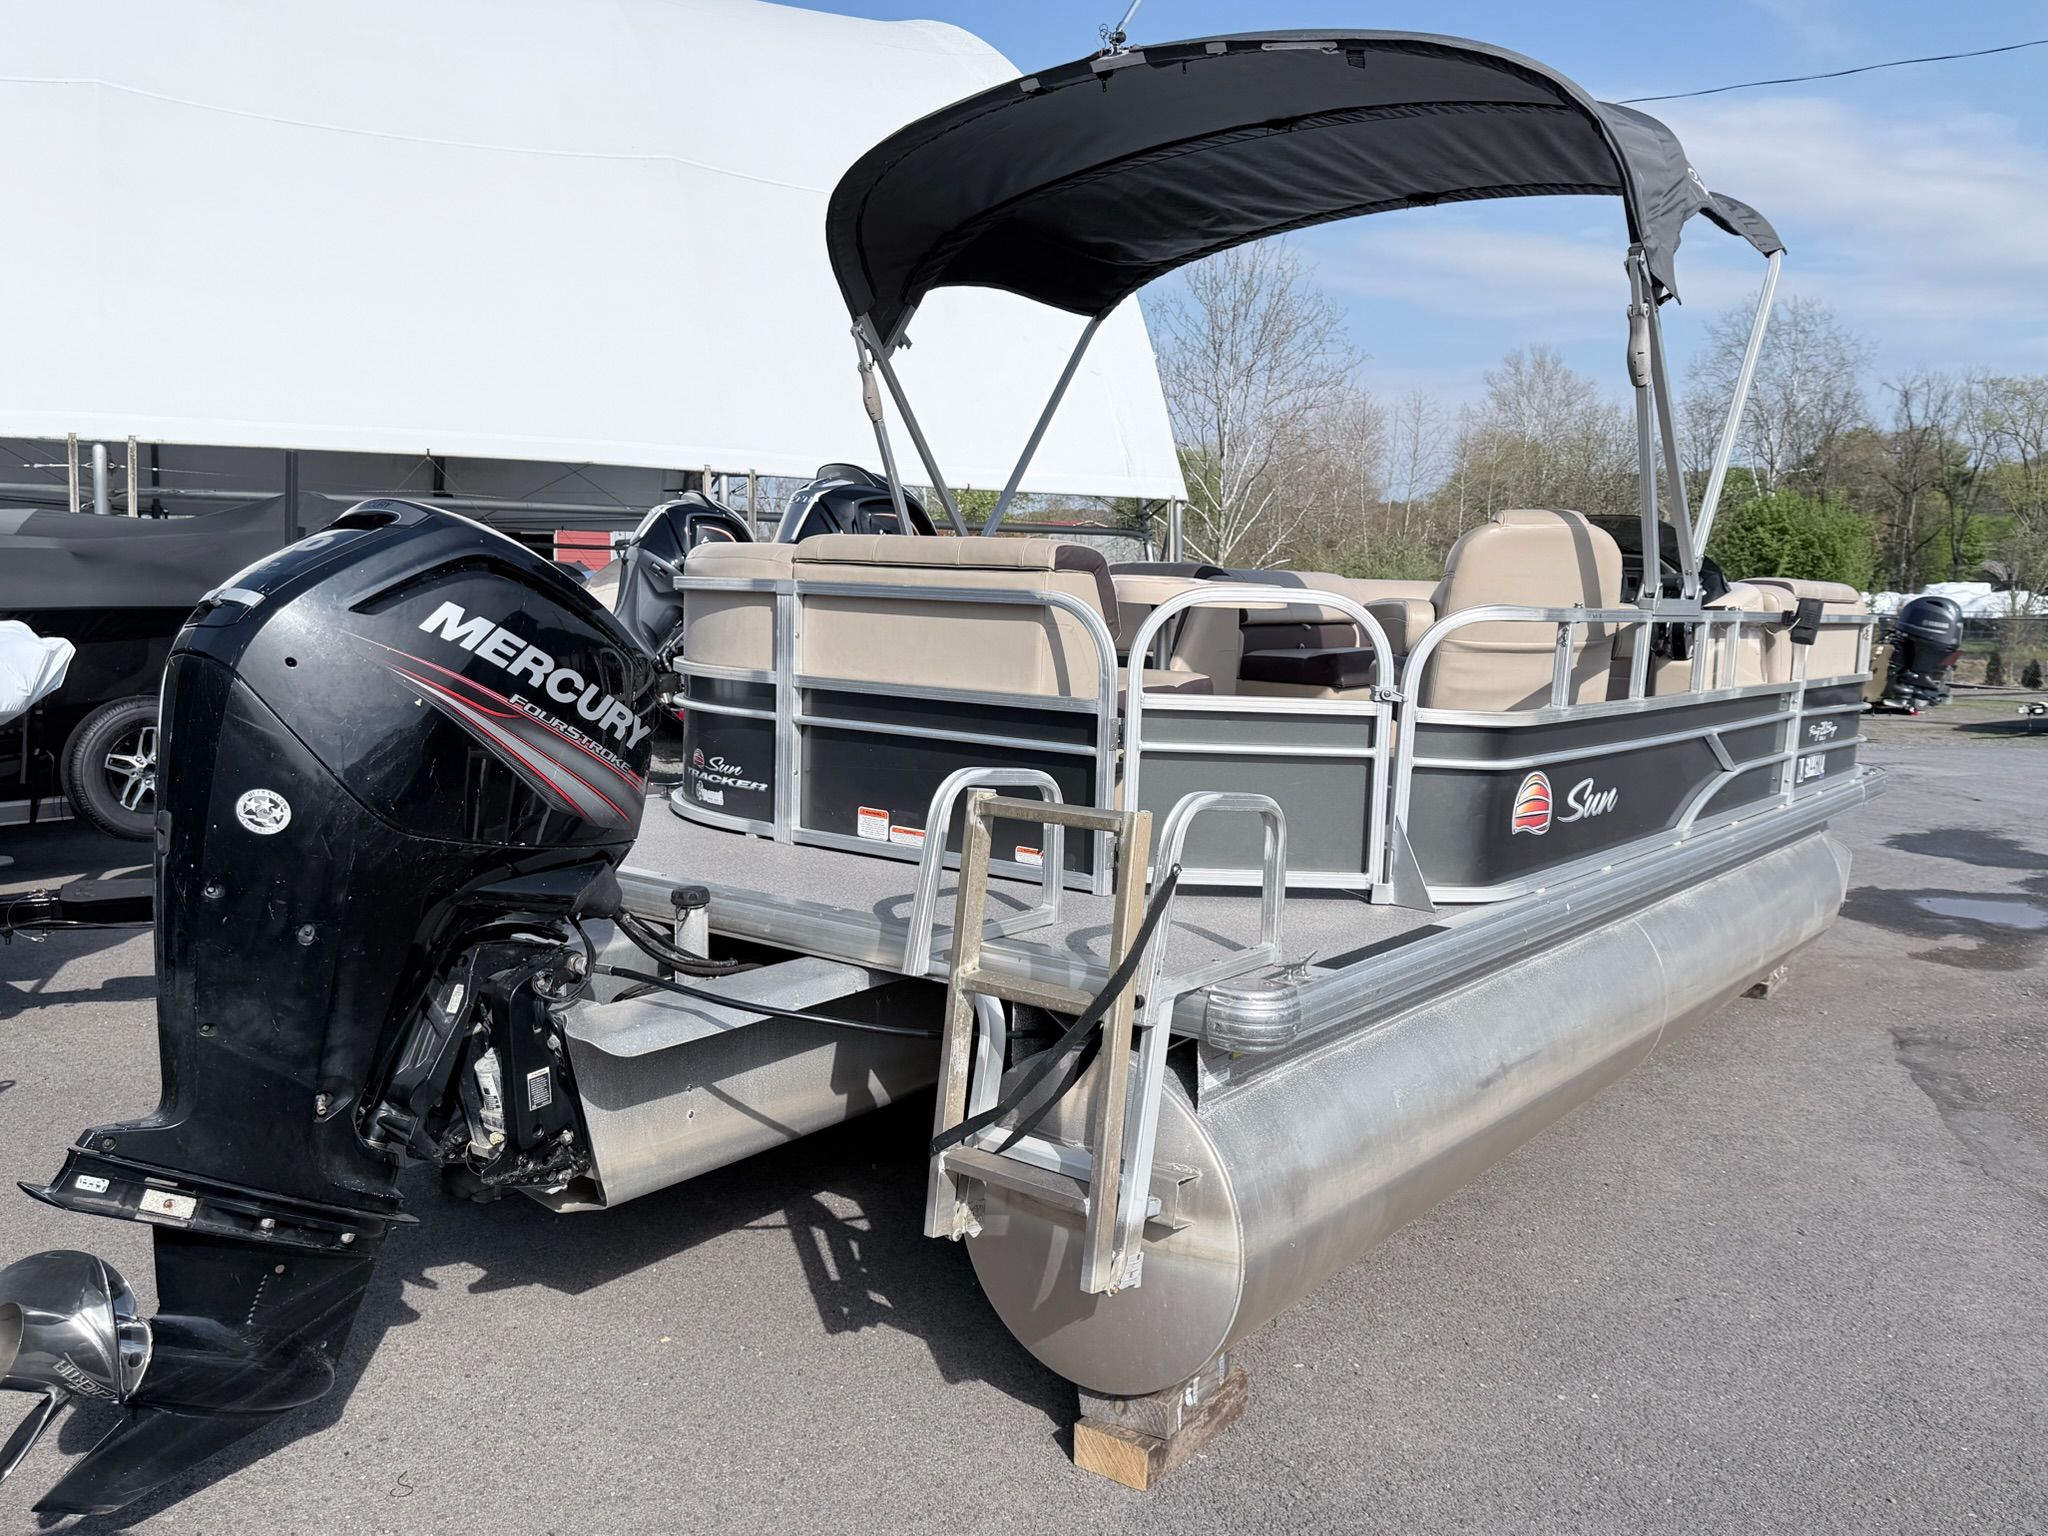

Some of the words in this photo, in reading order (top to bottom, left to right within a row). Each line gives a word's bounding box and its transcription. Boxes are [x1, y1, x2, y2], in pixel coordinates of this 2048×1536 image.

[419, 601, 651, 750] MERCURY
[508, 694, 633, 774] FOURSTROKE
[687, 766, 769, 793] TRACKER
[704, 756, 743, 776] Sun
[1557, 777, 1619, 823] Sun
